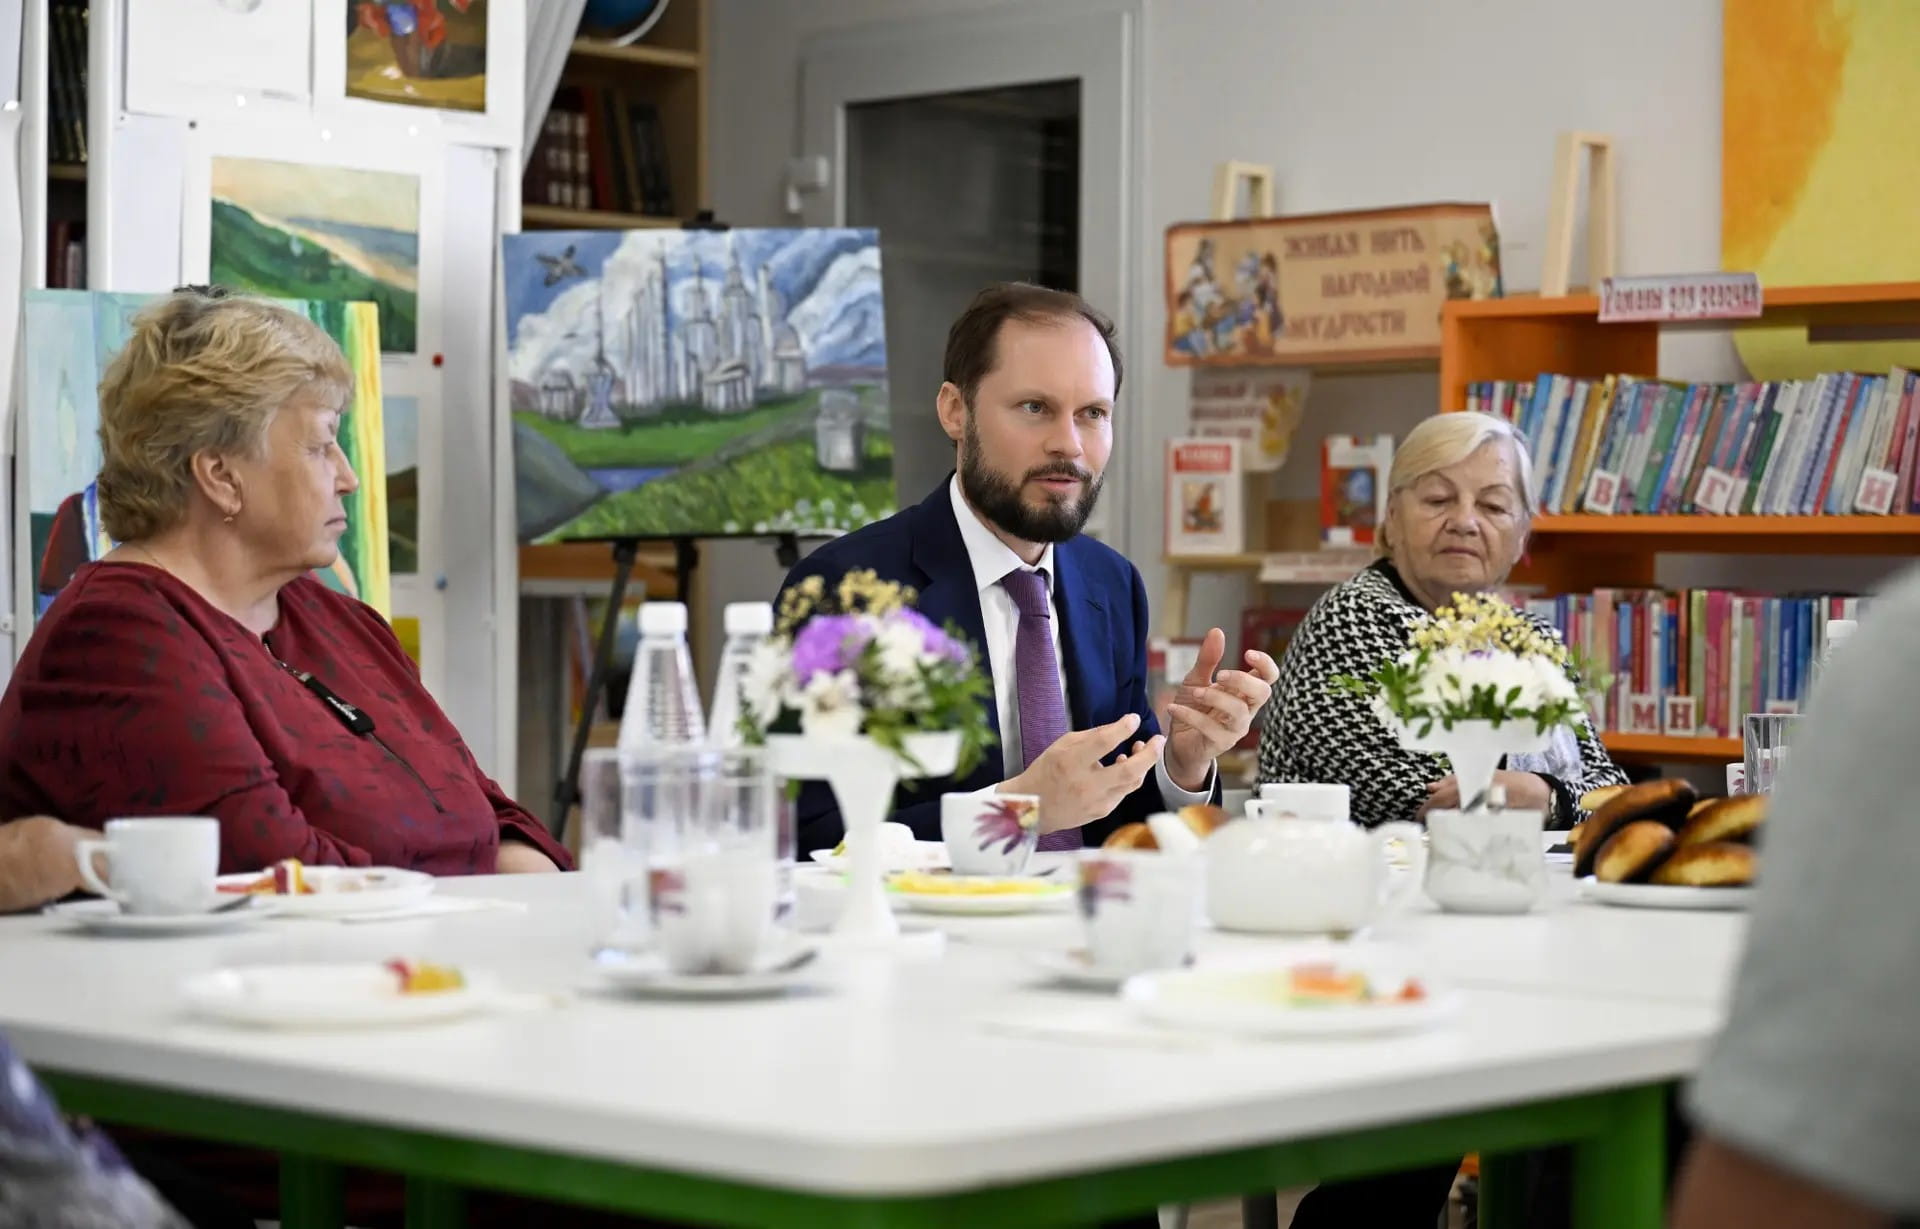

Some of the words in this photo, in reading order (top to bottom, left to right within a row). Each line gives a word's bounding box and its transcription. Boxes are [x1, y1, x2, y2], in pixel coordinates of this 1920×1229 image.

[1284, 231, 1360, 259] ЖИВАЯ
[1370, 227, 1426, 254] НИТЬ
[1320, 262, 1431, 298] НАРОДНОЙ
[1286, 309, 1406, 340] МУДРОСТИ
[1702, 476, 1728, 505] Г
[1632, 703, 1656, 730] М
[1669, 703, 1692, 730] Н
